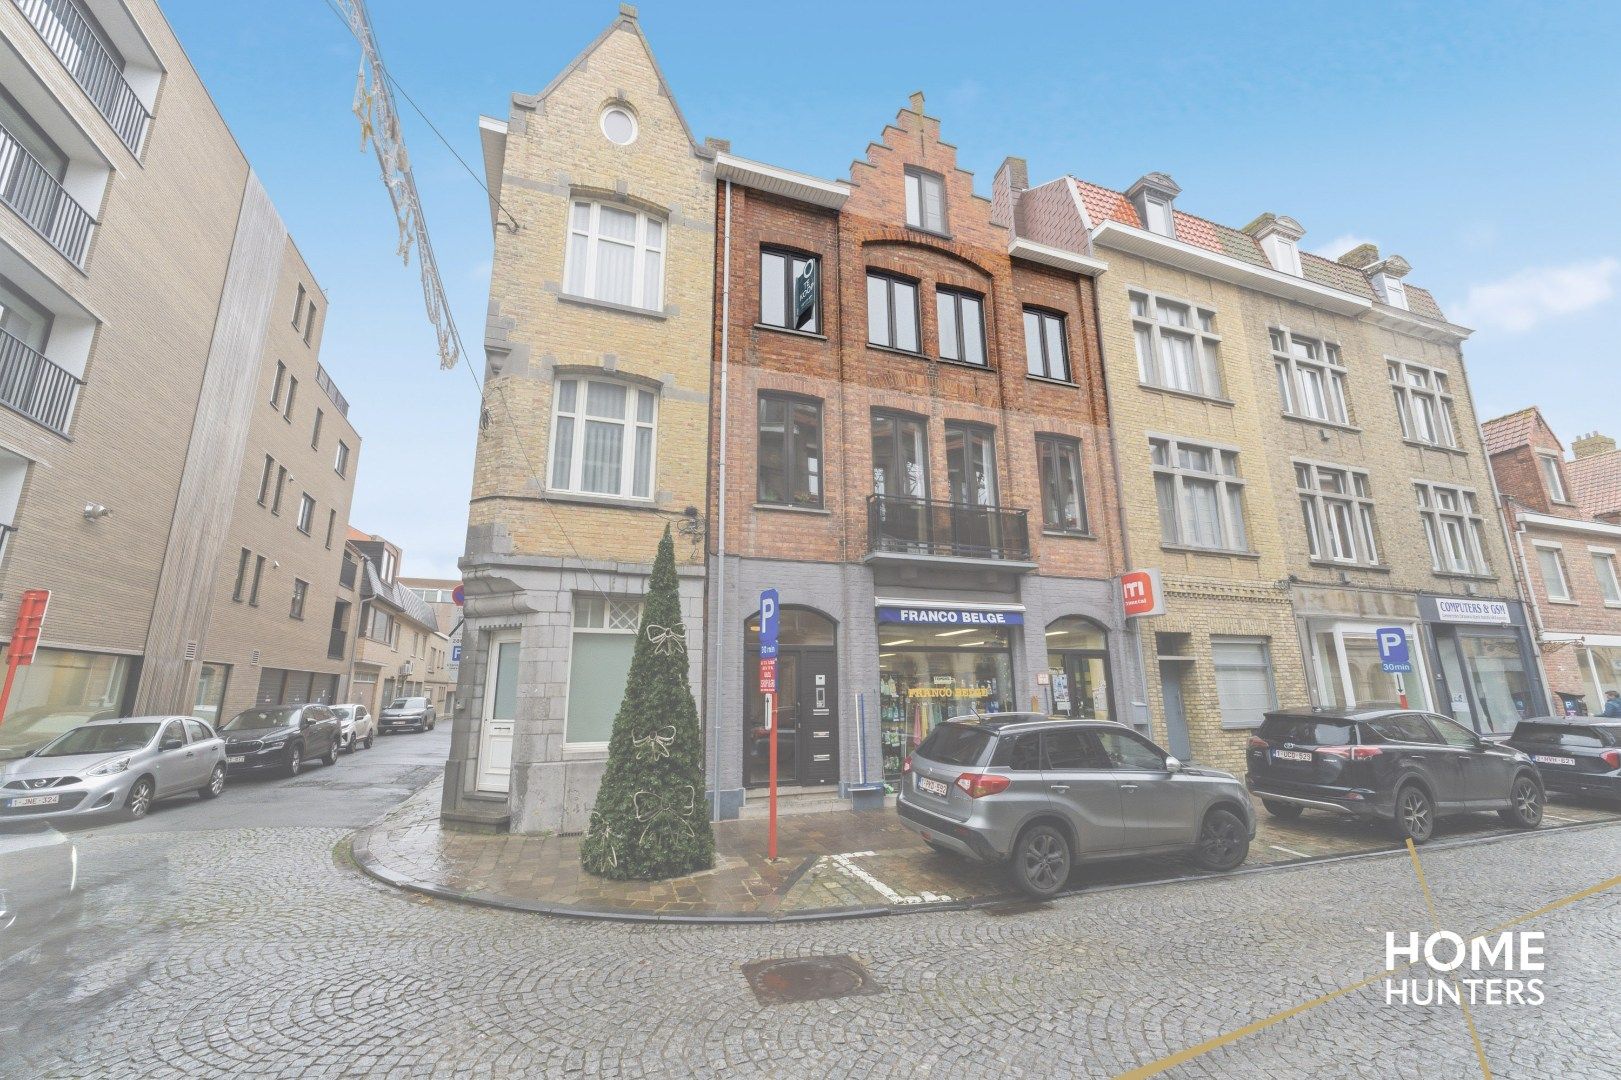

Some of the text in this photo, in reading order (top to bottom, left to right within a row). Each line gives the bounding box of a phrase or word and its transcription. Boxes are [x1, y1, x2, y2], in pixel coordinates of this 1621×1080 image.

[762, 598, 775, 634] P
[900, 609, 1006, 624] FRANCO BELGE
[1439, 601, 1507, 615] COMPUTERS & GSM
[1380, 633, 1401, 657] P
